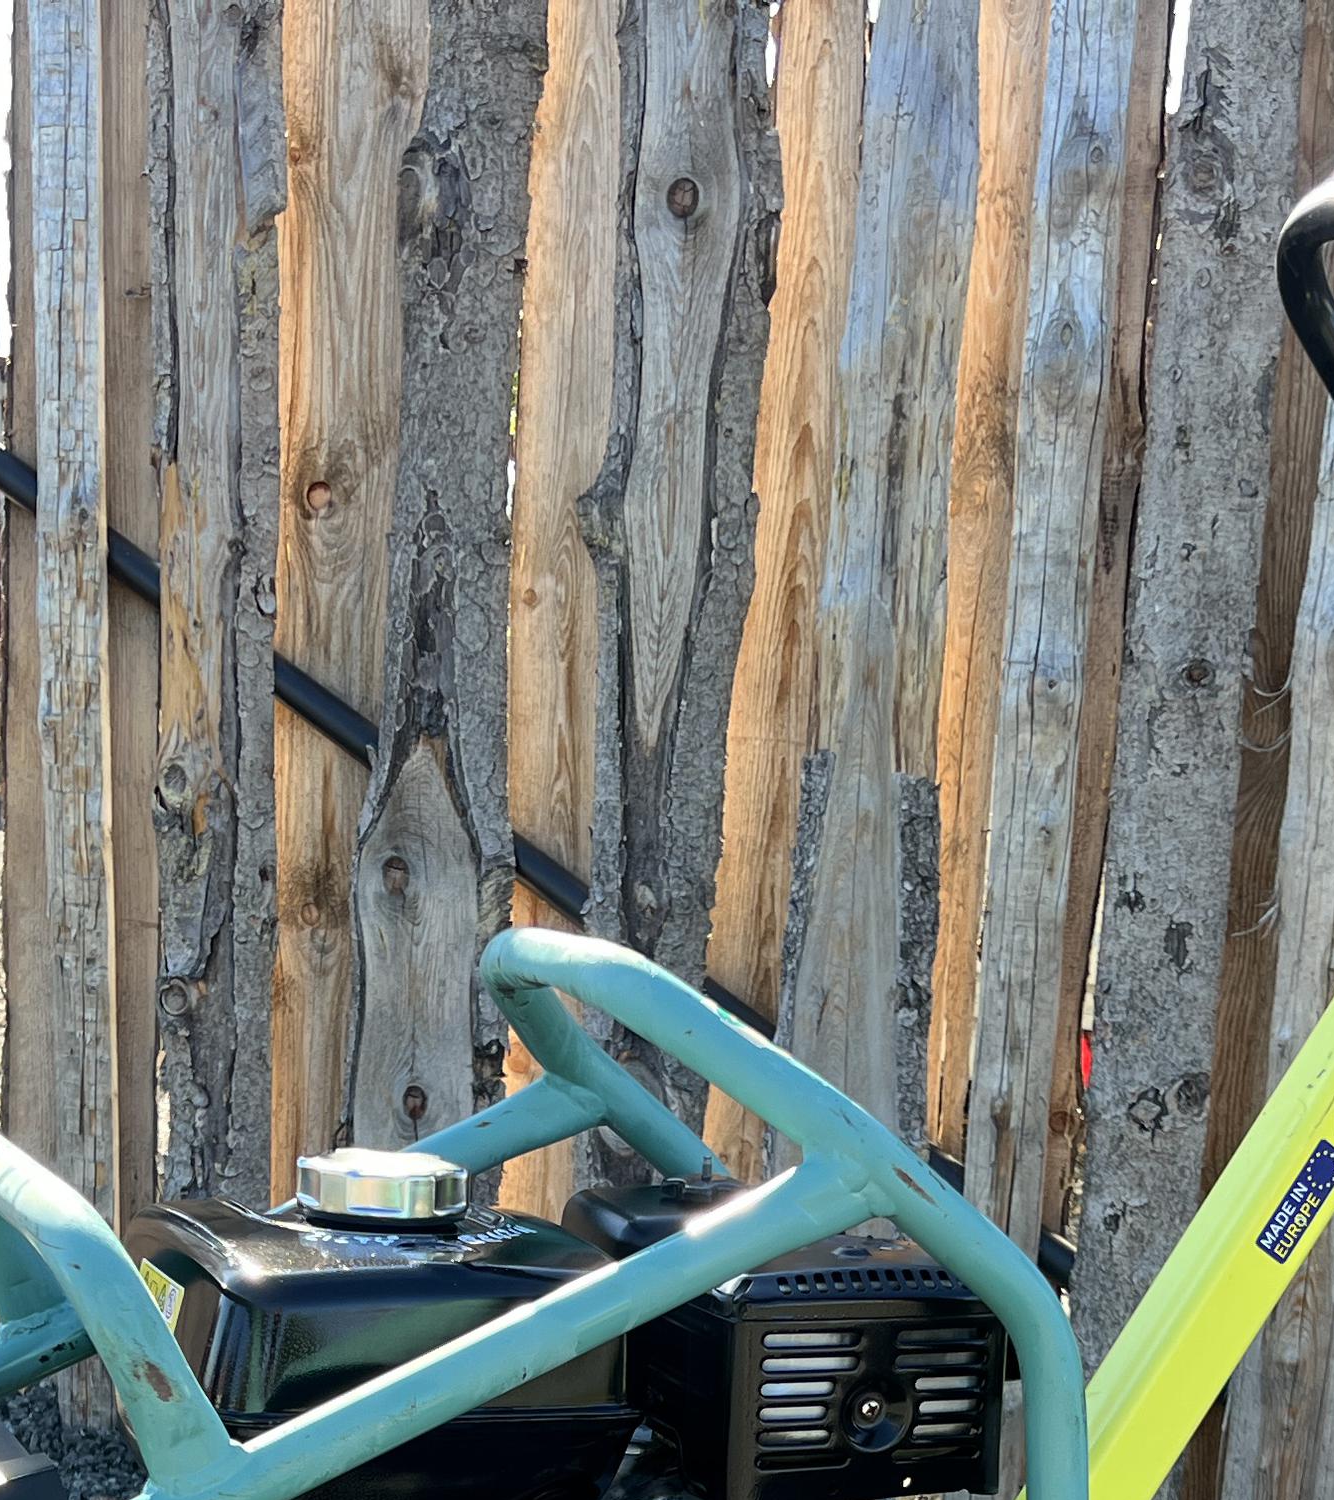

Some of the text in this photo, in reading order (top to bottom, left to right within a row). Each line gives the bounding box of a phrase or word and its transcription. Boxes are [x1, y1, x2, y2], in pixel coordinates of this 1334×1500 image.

[1260, 1182, 1309, 1249] MADE IN
[1273, 1192, 1321, 1259] EUROPE
